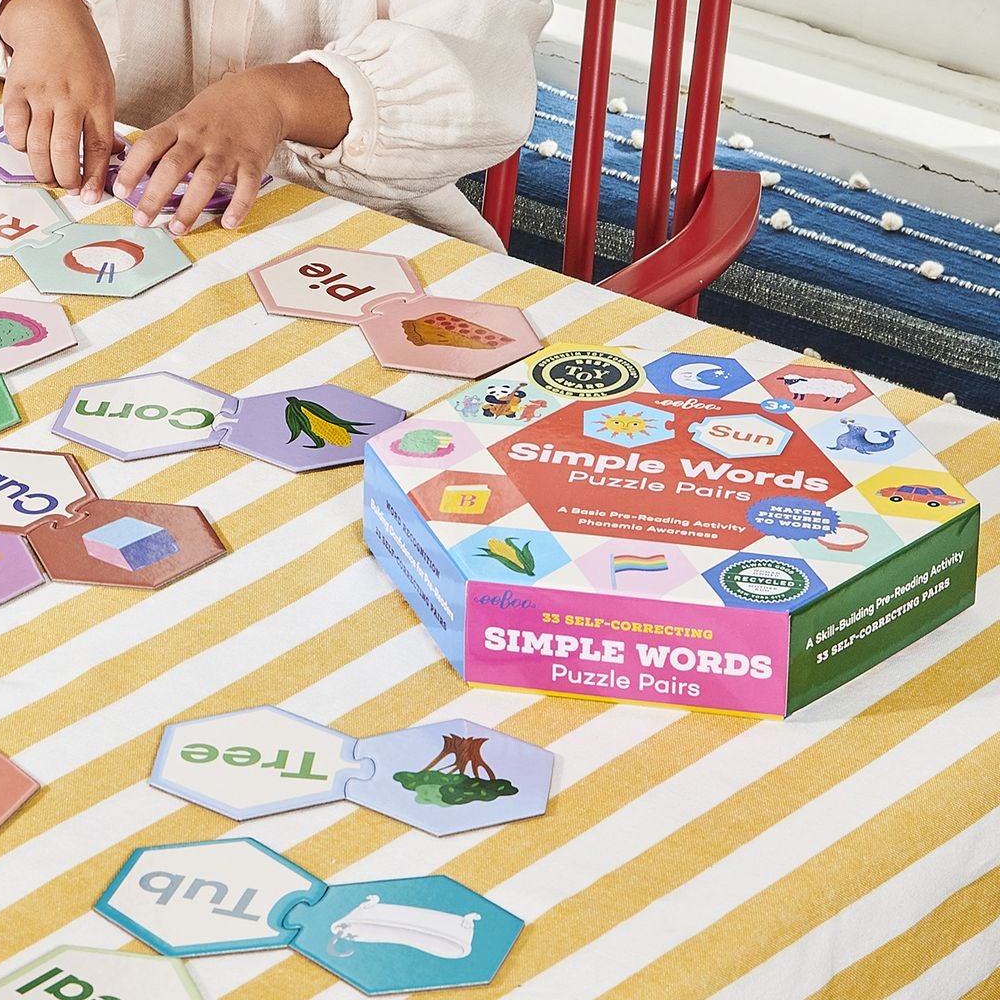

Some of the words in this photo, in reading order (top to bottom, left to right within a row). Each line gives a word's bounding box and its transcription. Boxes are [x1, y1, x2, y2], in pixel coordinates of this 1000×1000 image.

[298, 263, 376, 302] Pie
[565, 366, 610, 381] TOY
[575, 360, 610, 368] BEST
[555, 377, 605, 390] AWARD
[75, 400, 215, 430] Corn
[766, 401, 791, 411] 3+
[708, 425, 775, 446] Sun
[507, 442, 665, 475] Simple
[680, 458, 829, 492] Words
[568, 470, 665, 493] Puzzle
[676, 481, 752, 502] Pairs
[557, 506, 568, 514] A
[571, 507, 607, 517] Basic
[609, 511, 690, 527] Pre-Reading
[693, 520, 746, 533] Activity
[755, 517, 774, 525] TO
[779, 520, 831, 531] WORDS
[758, 511, 830, 524] PICTURES
[770, 506, 822, 517] MATCH
[578, 518, 643, 532] Phonemic
[646, 525, 719, 539] Awareness
[733, 574, 795, 587] RECYCLED
[805, 637, 814, 650] A
[815, 604, 875, 645] Skill-Building
[876, 571, 929, 610] Pre-Reading
[930, 550, 964, 578] Activity
[542, 612, 561, 624] 33
[565, 614, 714, 640] SELF-CORRECTING
[816, 651, 829, 664] 33
[831, 595, 920, 655] SELF-CORRECTING
[922, 577, 951, 602] PAIRS
[484, 626, 625, 664] SIMPLE
[636, 643, 773, 680] WORDS
[551, 663, 631, 689] Puzzle
[639, 673, 701, 697] Pairs
[181, 744, 328, 780] Tree
[139, 871, 260, 921] Tub
[16, 967, 122, 1000] al
